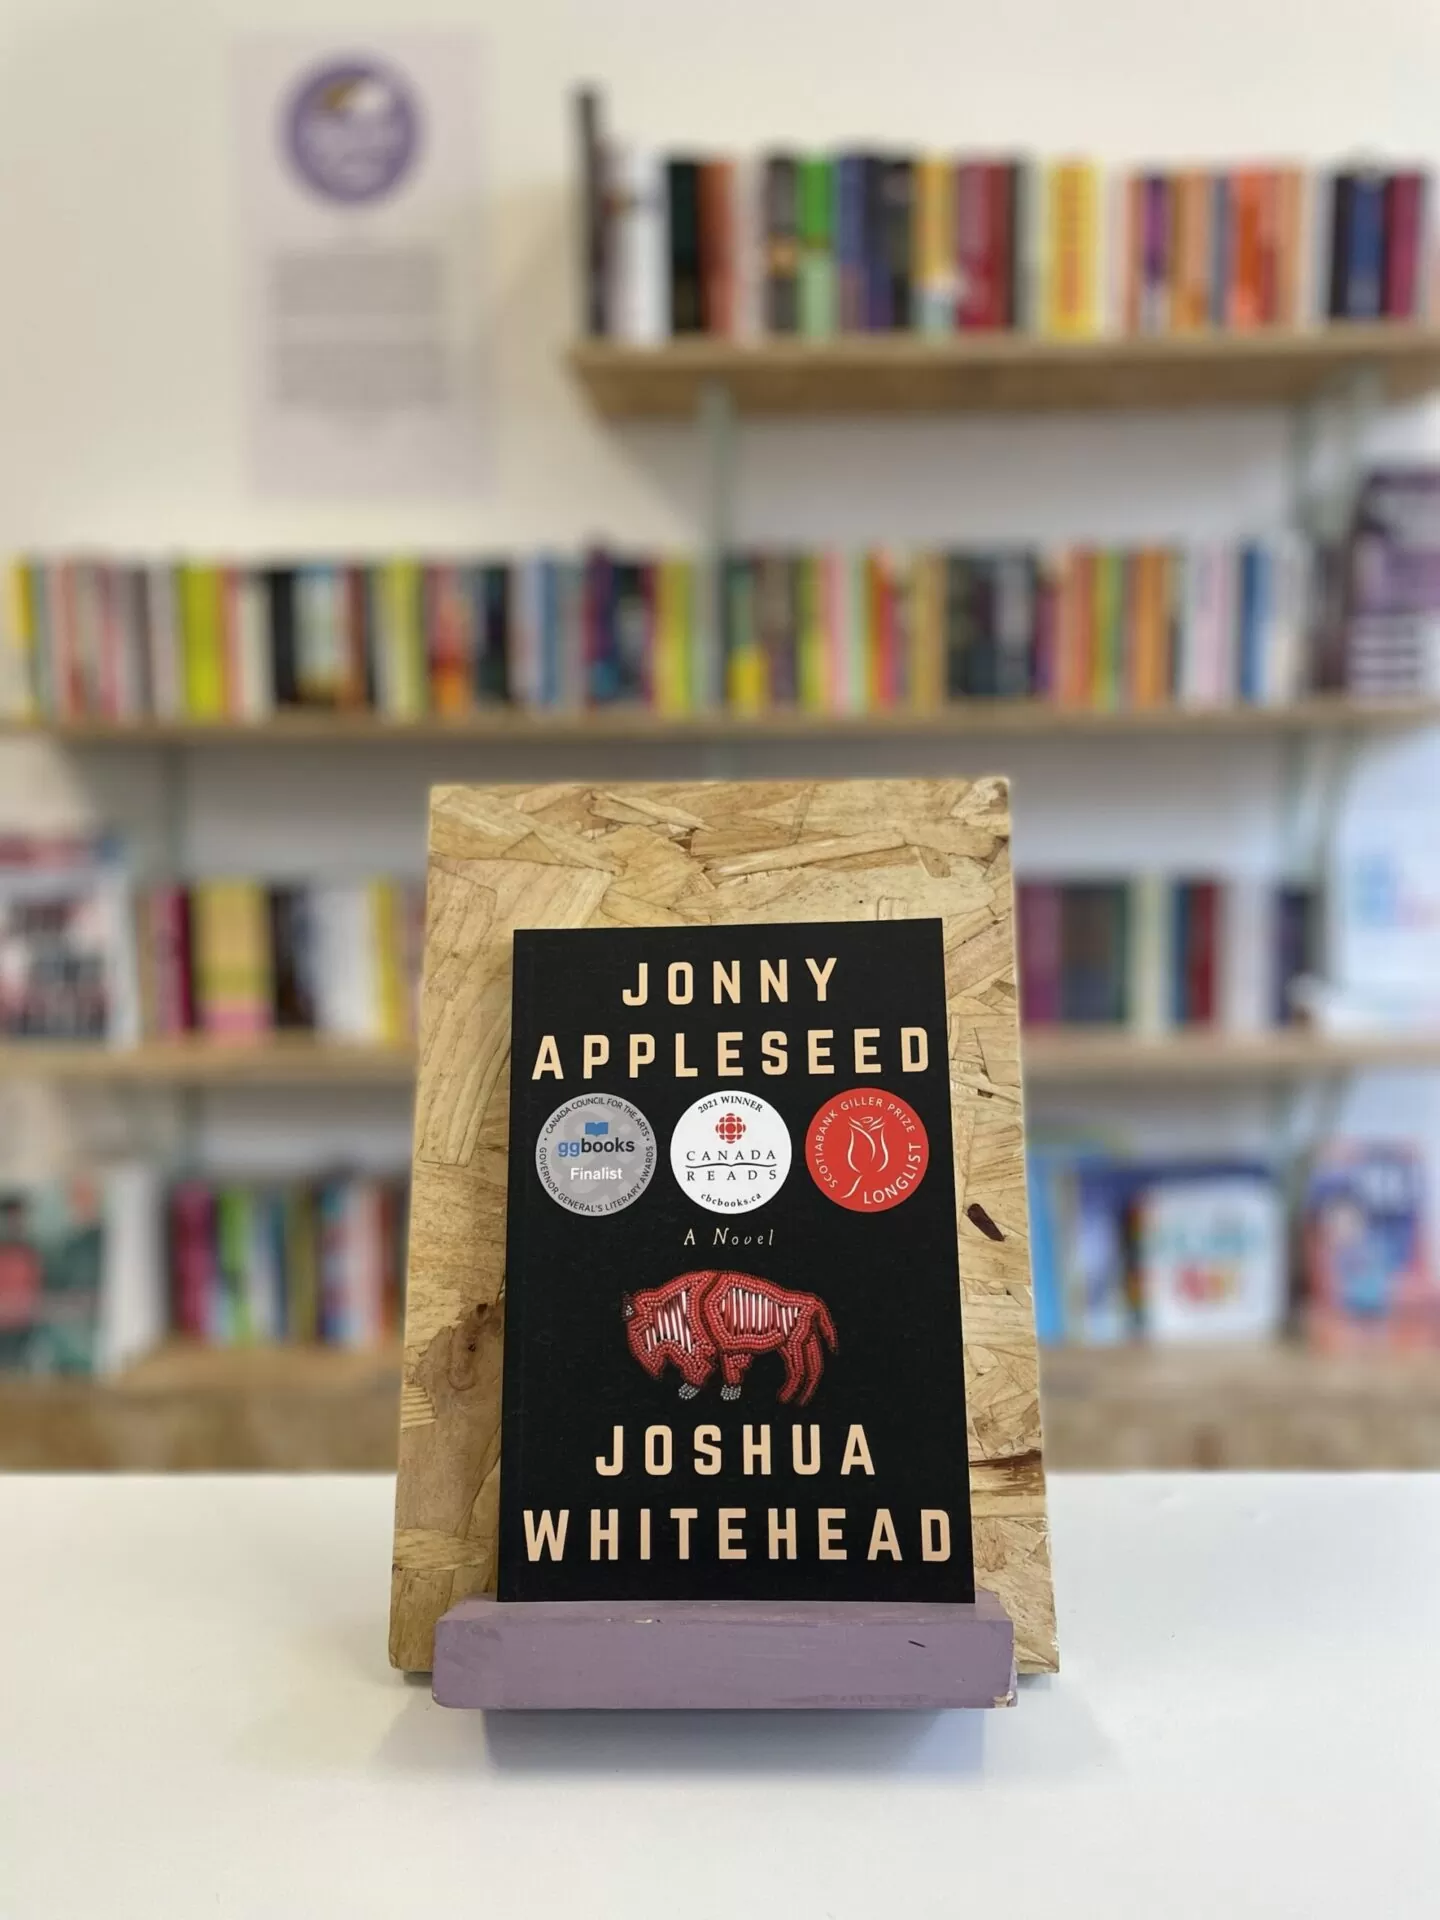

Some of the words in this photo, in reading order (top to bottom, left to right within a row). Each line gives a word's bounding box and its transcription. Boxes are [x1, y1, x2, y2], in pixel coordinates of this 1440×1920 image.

[622, 957, 838, 1007] JONNY
[531, 1026, 929, 1081] APPLESEED
[546, 1107, 571, 1134] CANADA
[571, 1097, 605, 1110] COUNCIL
[607, 1098, 623, 1109] FOR
[623, 1104, 638, 1119] THE
[635, 1117, 650, 1137] ARTS
[698, 1099, 718, 1113] 2021
[720, 1096, 763, 1112] WINNER
[557, 1136, 635, 1157] ggbooks
[686, 1149, 776, 1161] CANADA
[814, 1109, 838, 1188] SCOTIABANK
[840, 1096, 883, 1111] GILLER
[887, 1103, 916, 1133] PRIZE
[539, 1146, 560, 1195] GOVERNOR
[558, 1192, 603, 1212] GENERAL'S
[605, 1184, 641, 1211] LITERARY
[640, 1145, 654, 1183] AWARDS
[570, 1166, 623, 1180] Finalist
[687, 1169, 777, 1181] READS
[863, 1142, 921, 1204] LONGLIST
[700, 1193, 762, 1207] cbcbooks.ca
[683, 1228, 696, 1246] A
[712, 1227, 774, 1246] Novel
[595, 1424, 876, 1476] JOSHUA
[523, 1507, 951, 1562] WHITEHEAD
